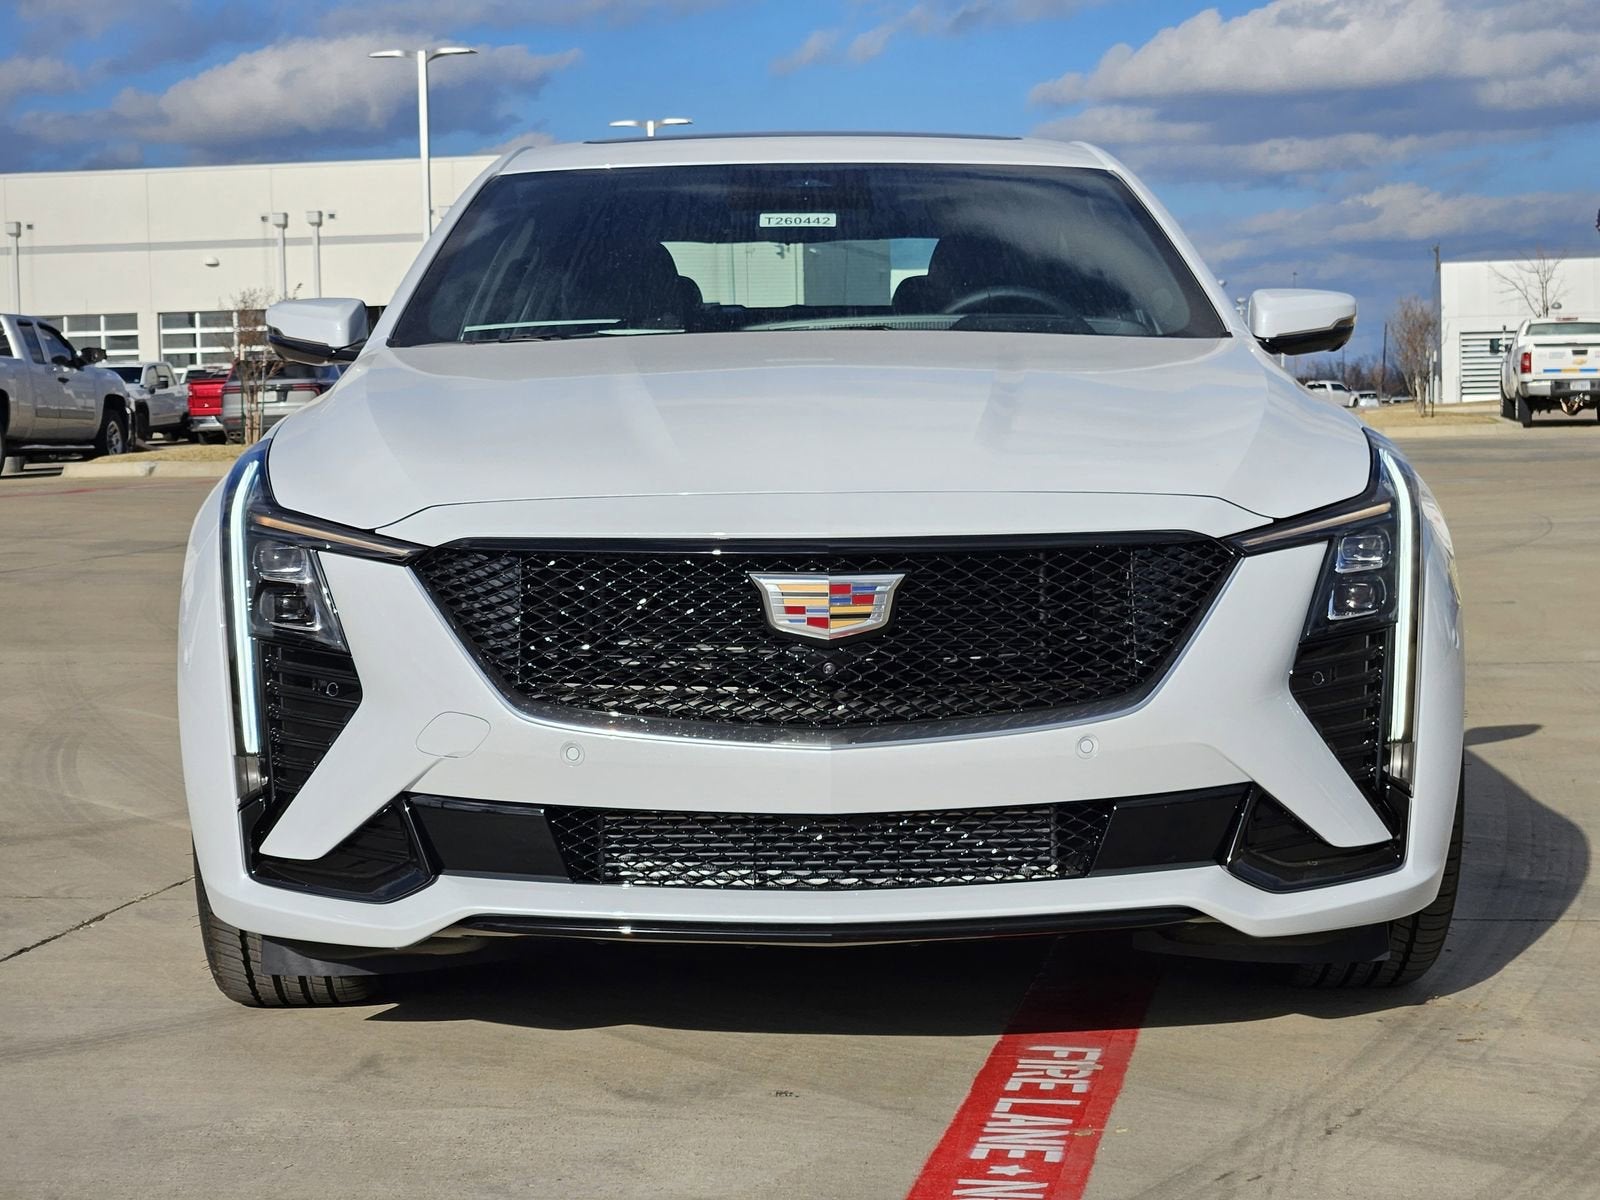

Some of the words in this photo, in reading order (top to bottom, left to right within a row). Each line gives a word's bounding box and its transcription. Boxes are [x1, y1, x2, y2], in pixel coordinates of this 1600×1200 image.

[764, 216, 831, 226] T260442
[1004, 1045, 1104, 1093] FIRE
[970, 1097, 1081, 1162] LANE
[951, 1179, 1049, 1200] N
